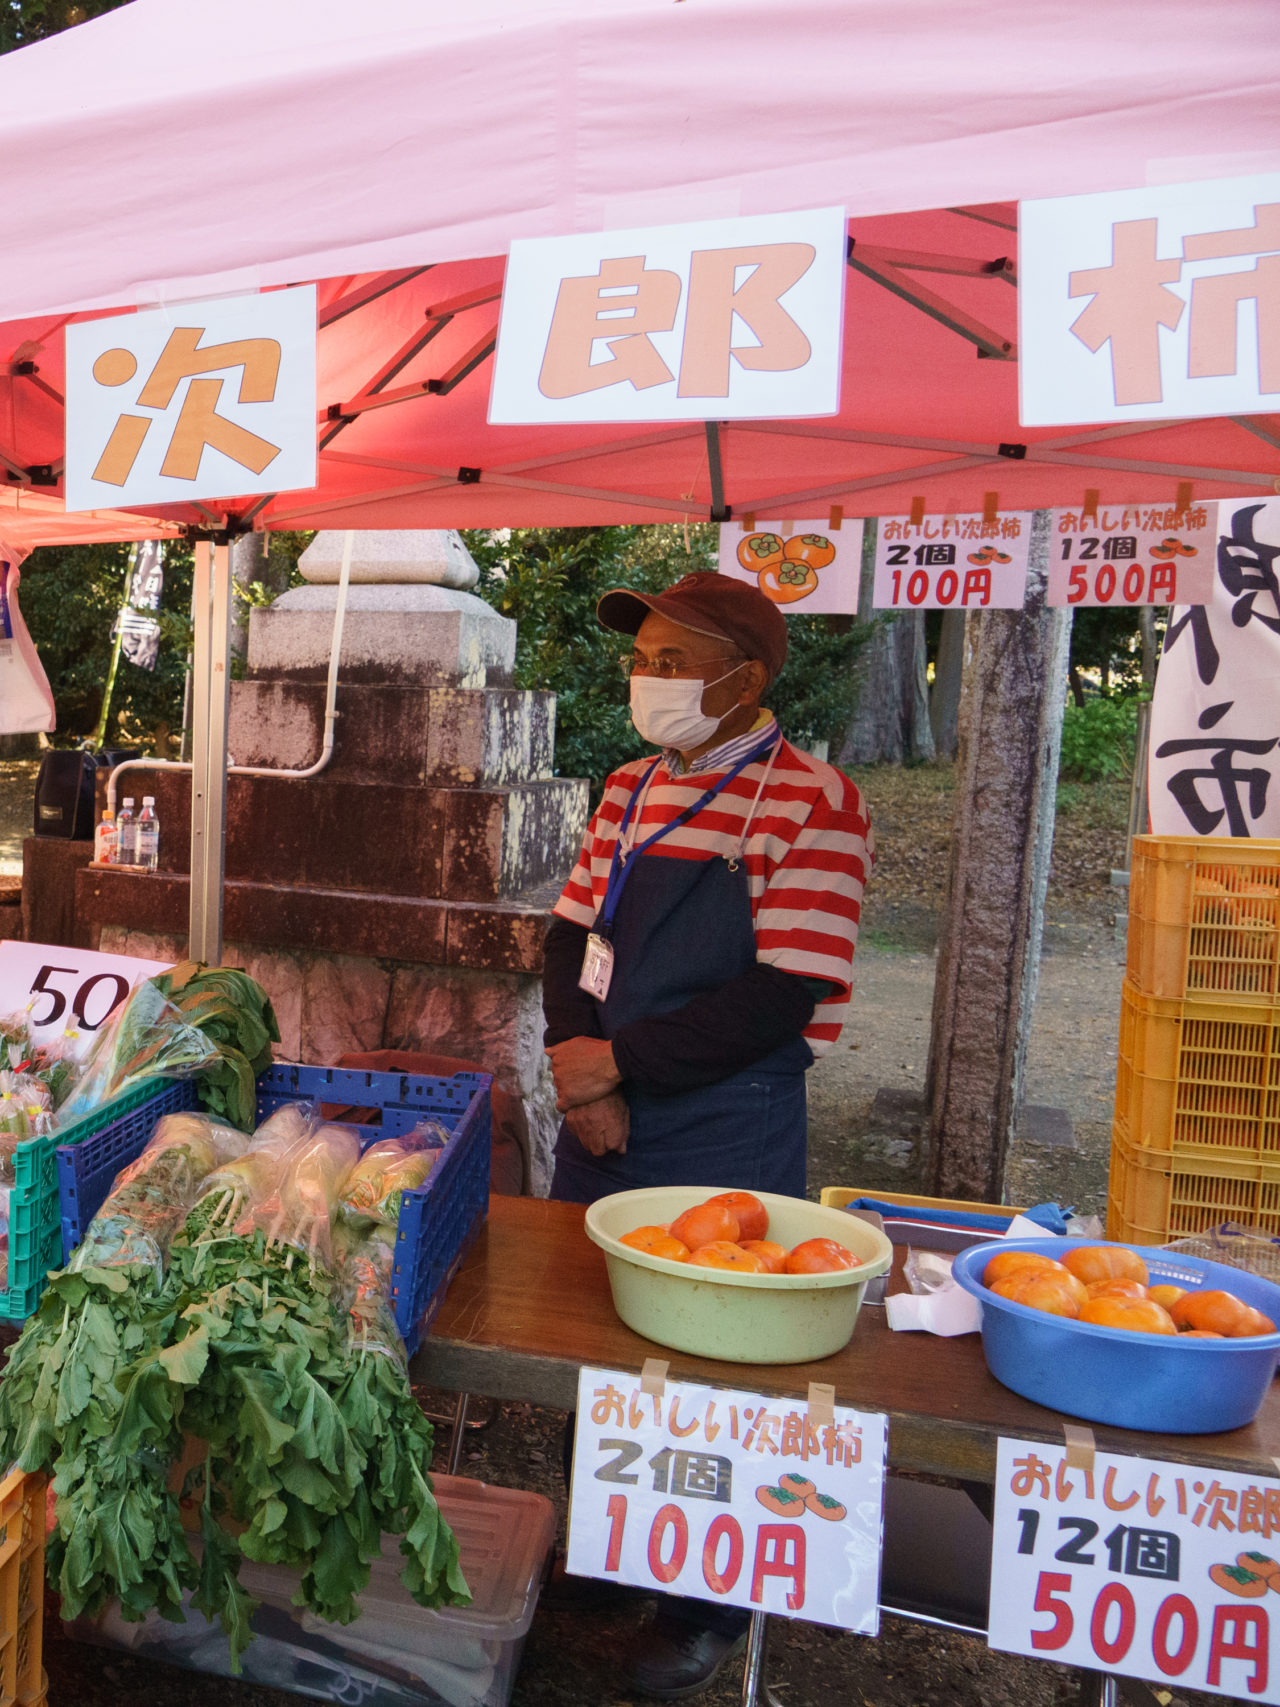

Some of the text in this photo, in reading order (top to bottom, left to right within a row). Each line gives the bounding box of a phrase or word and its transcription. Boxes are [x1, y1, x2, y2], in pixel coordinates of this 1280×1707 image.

[537, 242, 817, 400] 郎
[91, 326, 282, 487] 次
[885, 543, 956, 566] 2個
[1061, 536, 1137, 560] 12個
[1067, 562, 1177, 604] 500円
[892, 568, 992, 606] 100円
[29, 964, 130, 1032] 50
[590, 1384, 863, 1469] おいしい次郎柿
[593, 1437, 734, 1504] 2個
[604, 1494, 807, 1611] 100円
[1016, 1507, 1181, 1582] 12個
[1029, 1570, 1269, 1695] 500円
